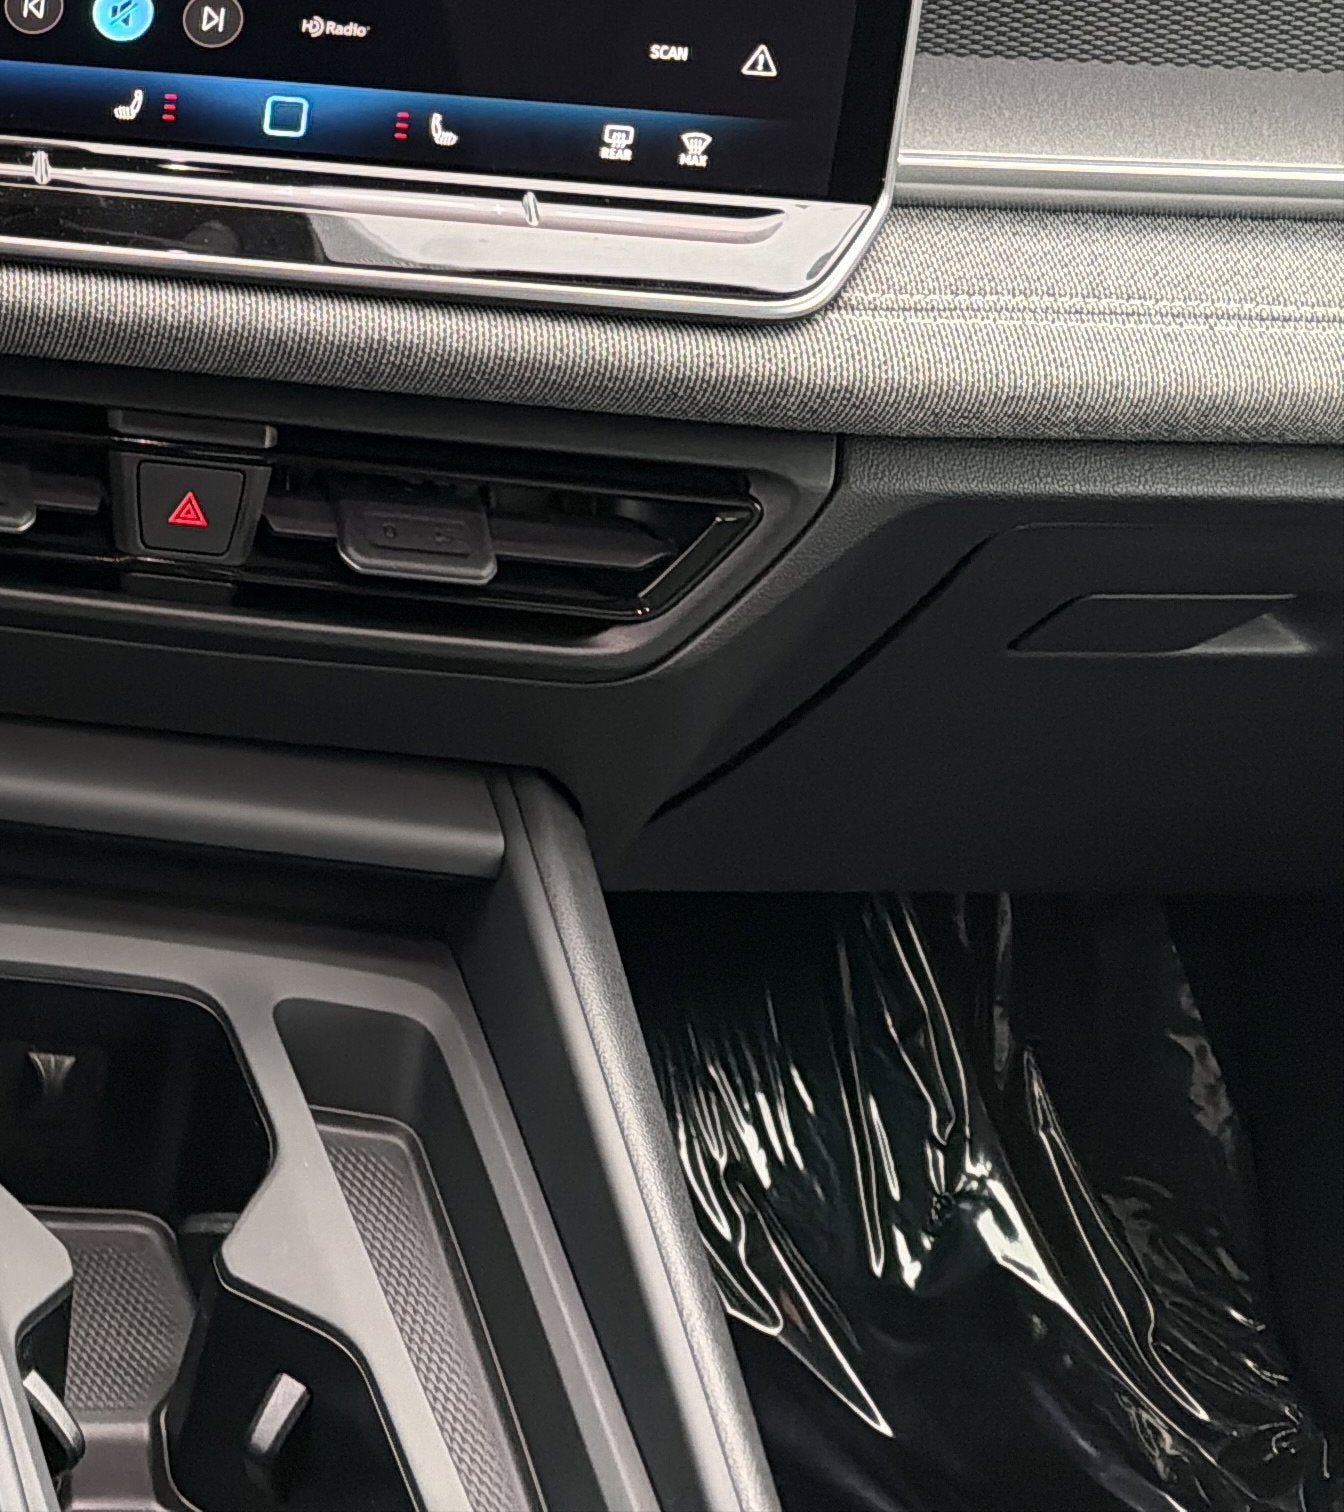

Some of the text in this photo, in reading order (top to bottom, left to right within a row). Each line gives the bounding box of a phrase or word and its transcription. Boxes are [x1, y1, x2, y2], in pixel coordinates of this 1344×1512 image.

[649, 44, 689, 61] SCAN
[598, 147, 633, 162] REAR
[677, 153, 709, 168] MAX
